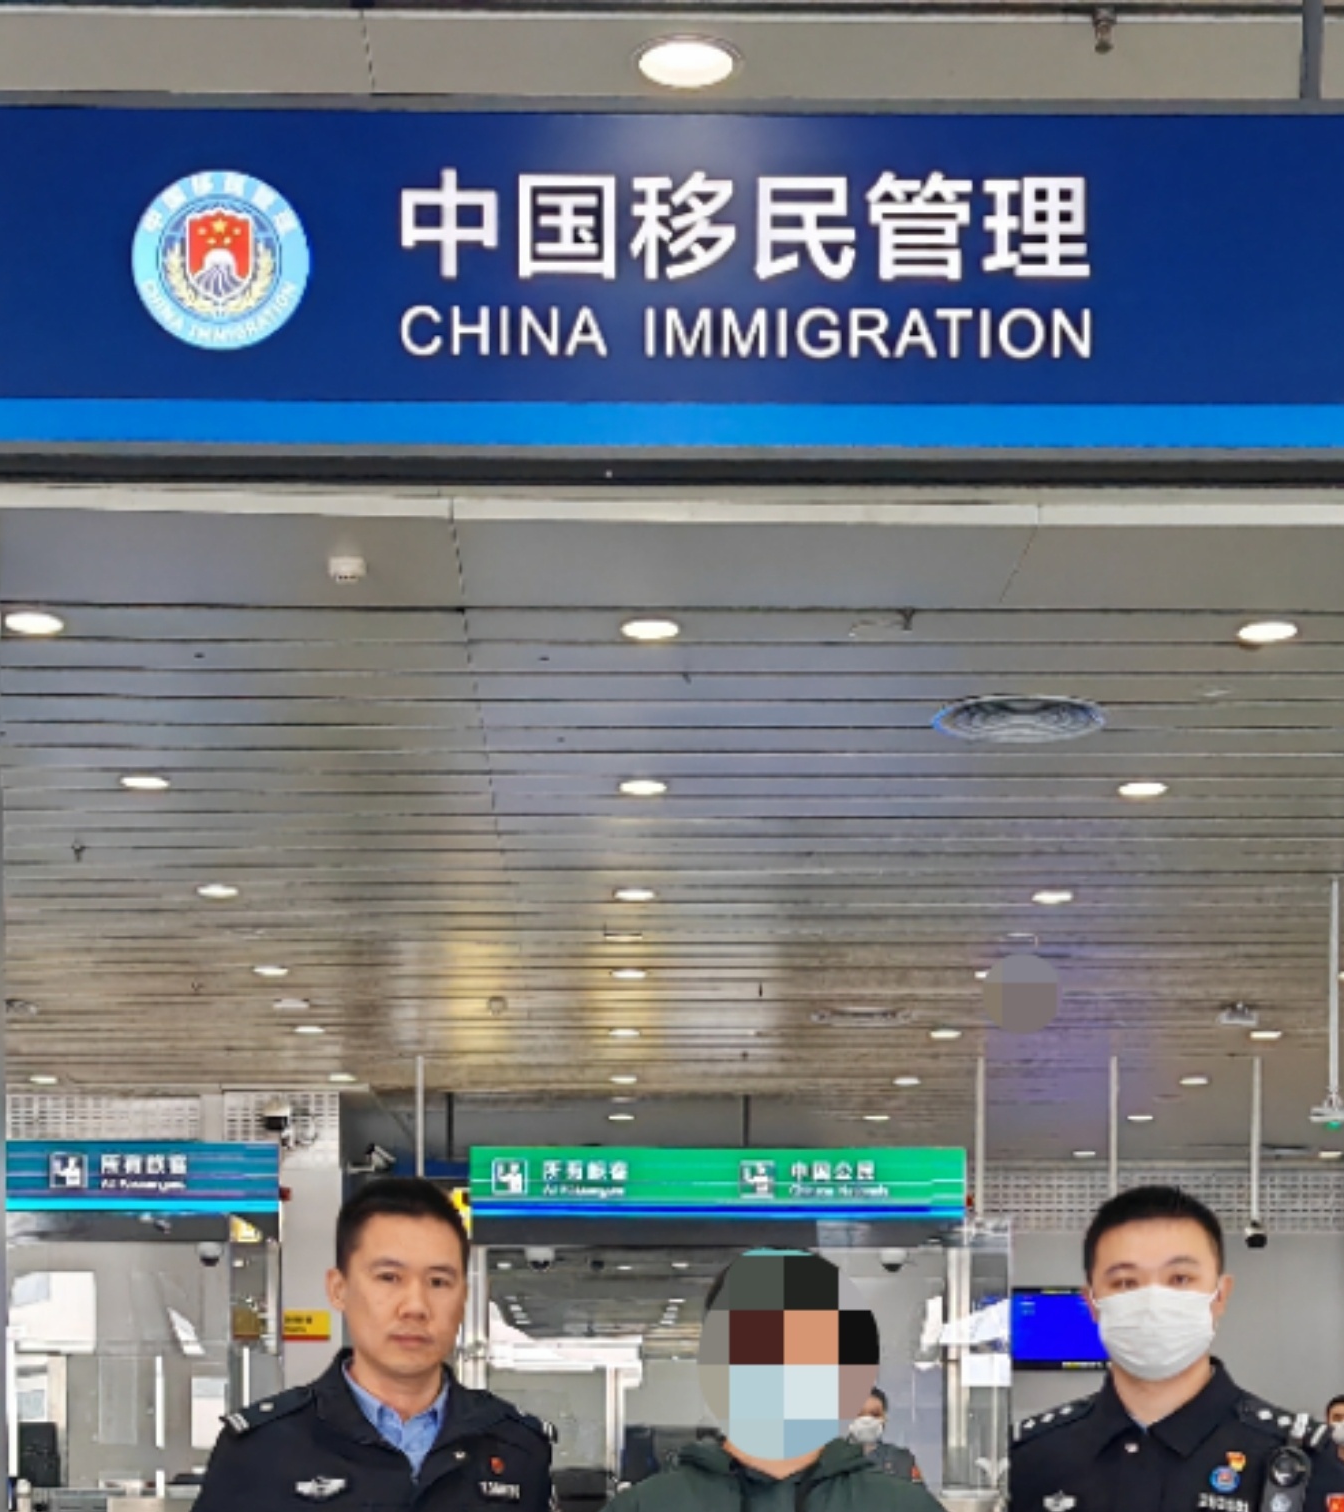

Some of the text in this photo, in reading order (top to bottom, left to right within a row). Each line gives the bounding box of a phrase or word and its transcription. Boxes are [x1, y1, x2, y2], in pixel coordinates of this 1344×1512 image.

[400, 167, 1091, 282] 中国移民管理
[401, 305, 1093, 358] CHINA IMMIGRATION
